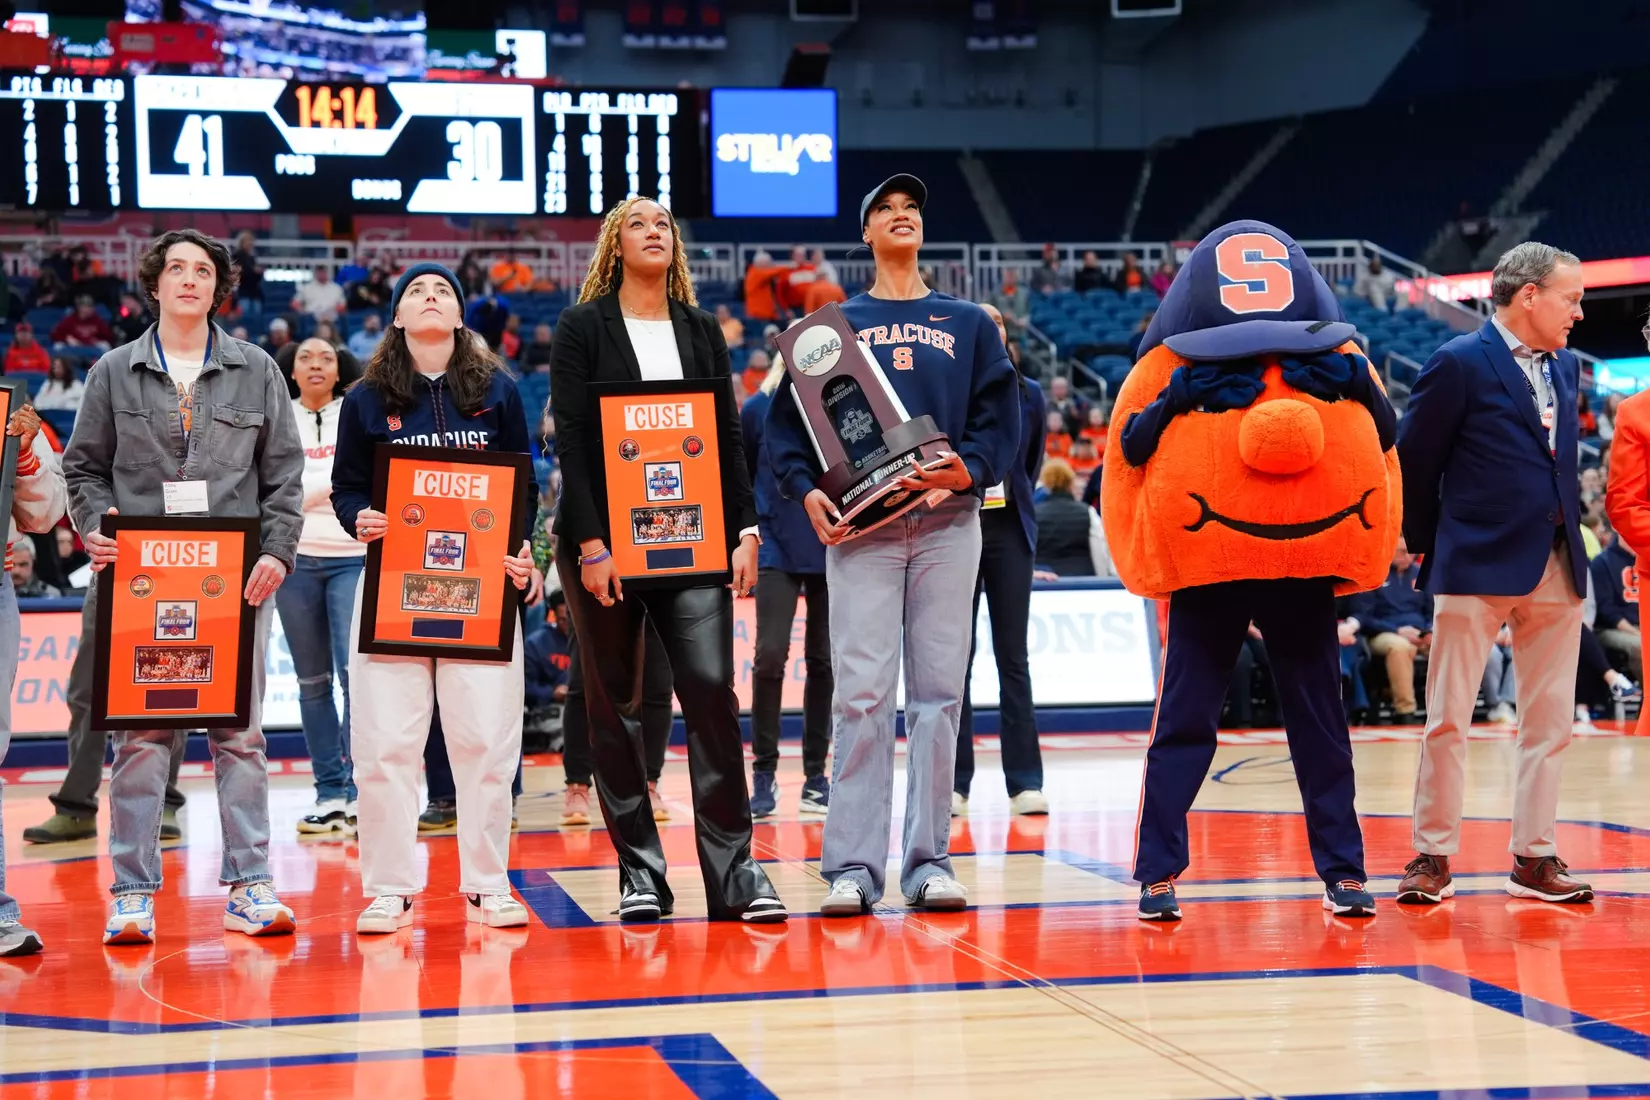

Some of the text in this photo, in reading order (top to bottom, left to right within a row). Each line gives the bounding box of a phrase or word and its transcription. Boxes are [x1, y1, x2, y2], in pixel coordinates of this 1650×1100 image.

[295, 85, 378, 129] 14:14
[173, 114, 224, 175] 41
[446, 120, 503, 181] 30
[1216, 233, 1294, 314] S
[800, 338, 841, 369] NCAA
[856, 324, 956, 357] YRACUSE
[893, 347, 913, 370] S
[827, 385, 854, 406] DIVISION
[627, 404, 688, 428] 'CUSE
[392, 430, 489, 450] RACUSE
[417, 471, 482, 499] 'CUSE
[841, 478, 874, 505] NATIONAL
[872, 452, 916, 484] RUNNER-UP
[145, 541, 211, 565] 'CUSE
